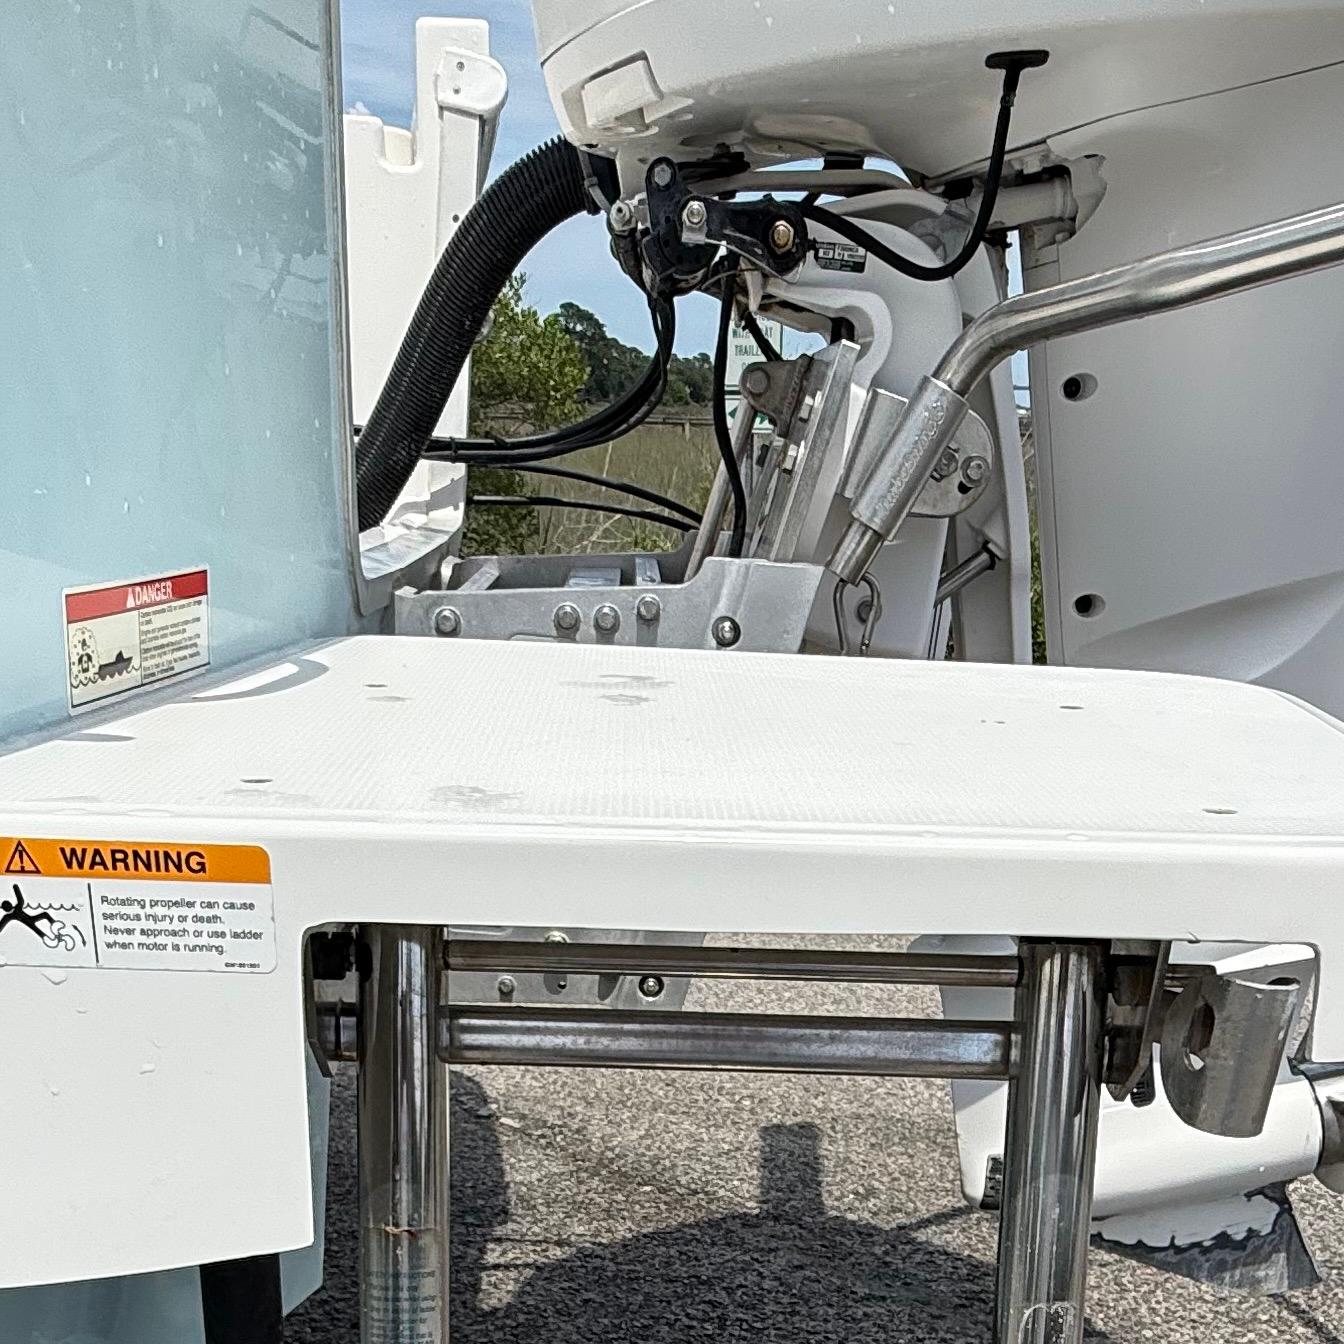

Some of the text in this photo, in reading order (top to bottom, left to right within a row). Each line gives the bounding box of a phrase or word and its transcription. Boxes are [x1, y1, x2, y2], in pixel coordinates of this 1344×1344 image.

[135, 580, 173, 606] DANGER
[59, 846, 207, 874] WARNING
[100, 895, 256, 911] Rotating propeller can cause
[102, 911, 142, 921] serious
[144, 912, 174, 925] injury
[191, 913, 225, 924] death.
[104, 925, 264, 941] Never approach or use ladder
[105, 939, 134, 950] when
[137, 941, 168, 951] motor
[171, 942, 181, 952] is
